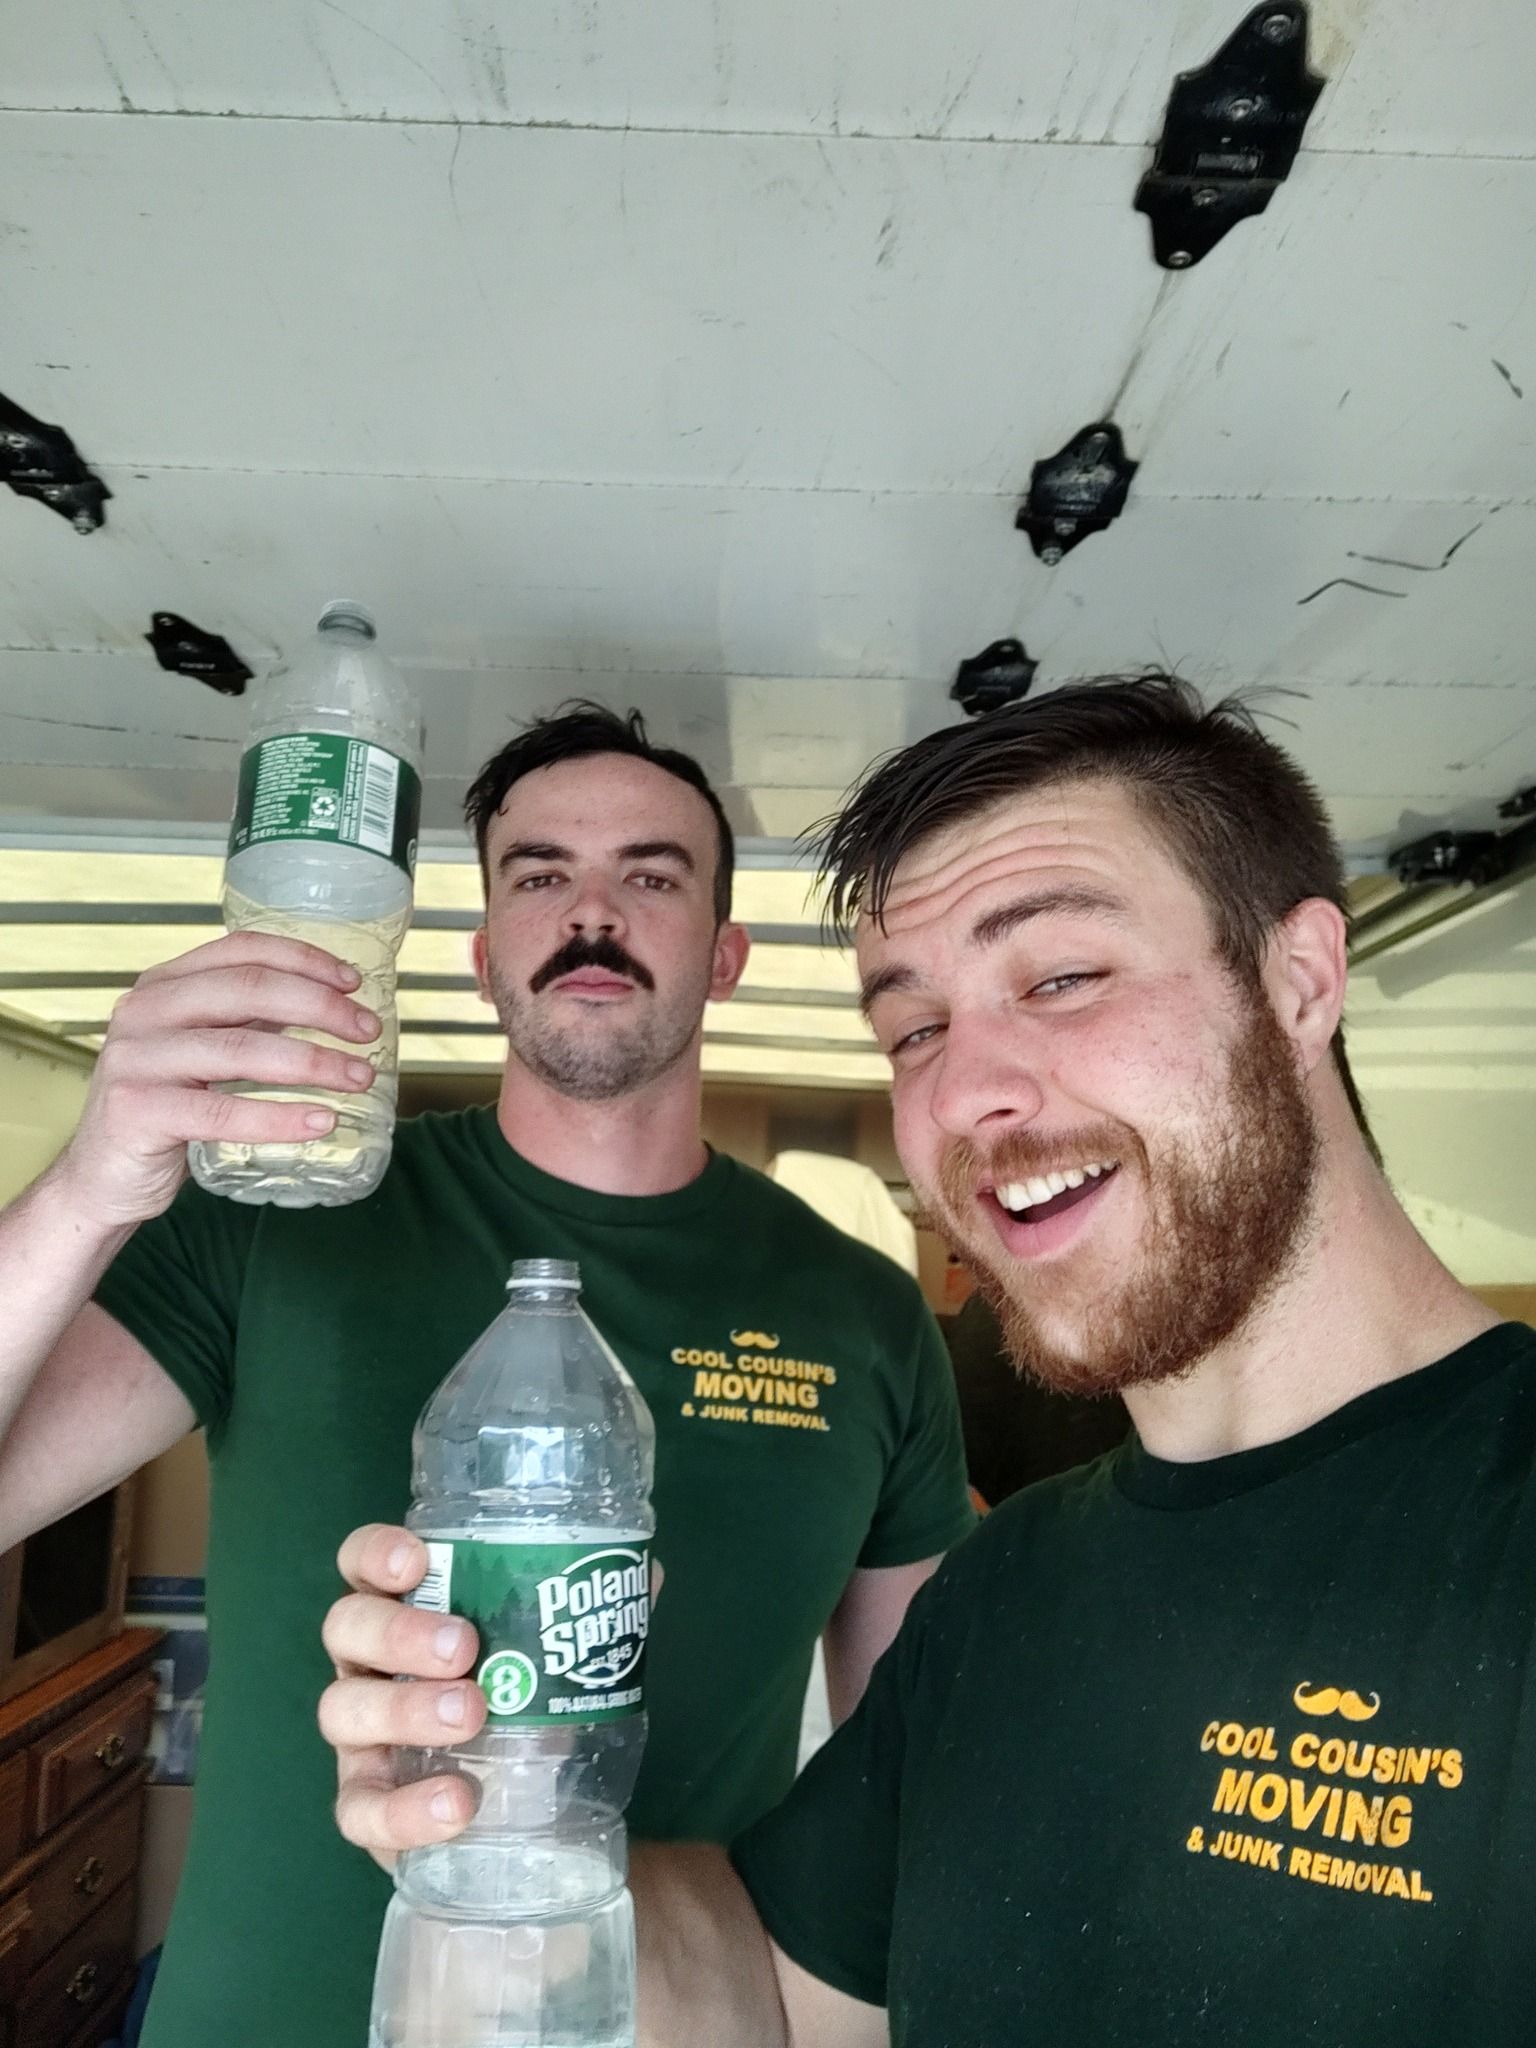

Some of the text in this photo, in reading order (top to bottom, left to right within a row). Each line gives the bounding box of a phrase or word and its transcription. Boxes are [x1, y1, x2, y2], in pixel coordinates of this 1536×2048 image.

[671, 1348, 837, 1385] COOL COUSIN'S
[694, 1371, 819, 1409] MOVING
[681, 1402, 830, 1431] & JUNK REMOVAL
[536, 1549, 649, 1632] Poland
[540, 1596, 649, 1676] Spring
[1200, 1720, 1463, 1789] COOL COUSIN'S
[1211, 1767, 1413, 1848] MOVING
[1186, 1825, 1433, 1902] & JUNK REMOVAL
